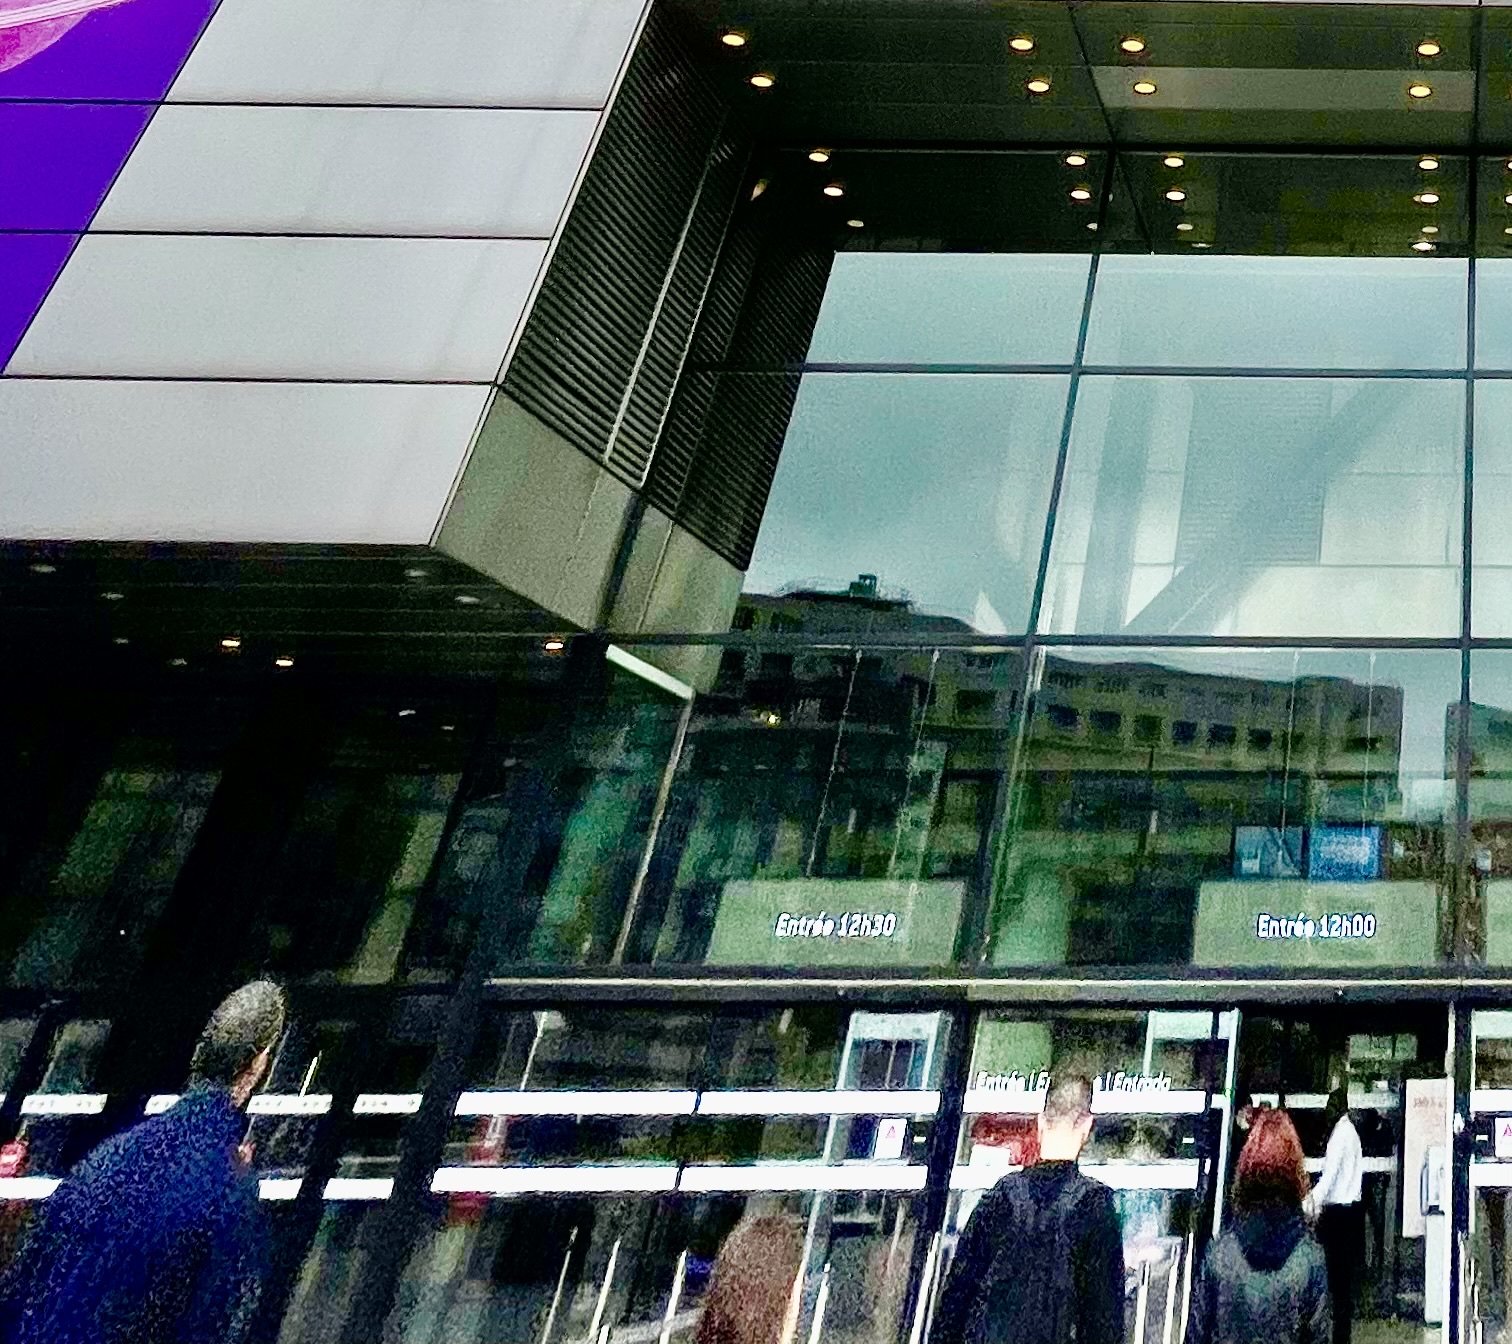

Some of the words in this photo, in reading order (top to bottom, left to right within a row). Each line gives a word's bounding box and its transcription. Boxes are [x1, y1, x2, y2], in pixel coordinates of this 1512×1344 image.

[775, 910, 835, 938] Entrée
[837, 911, 898, 938] 12h30
[1257, 912, 1316, 938] Entrée
[1318, 912, 1377, 938] 12h00
